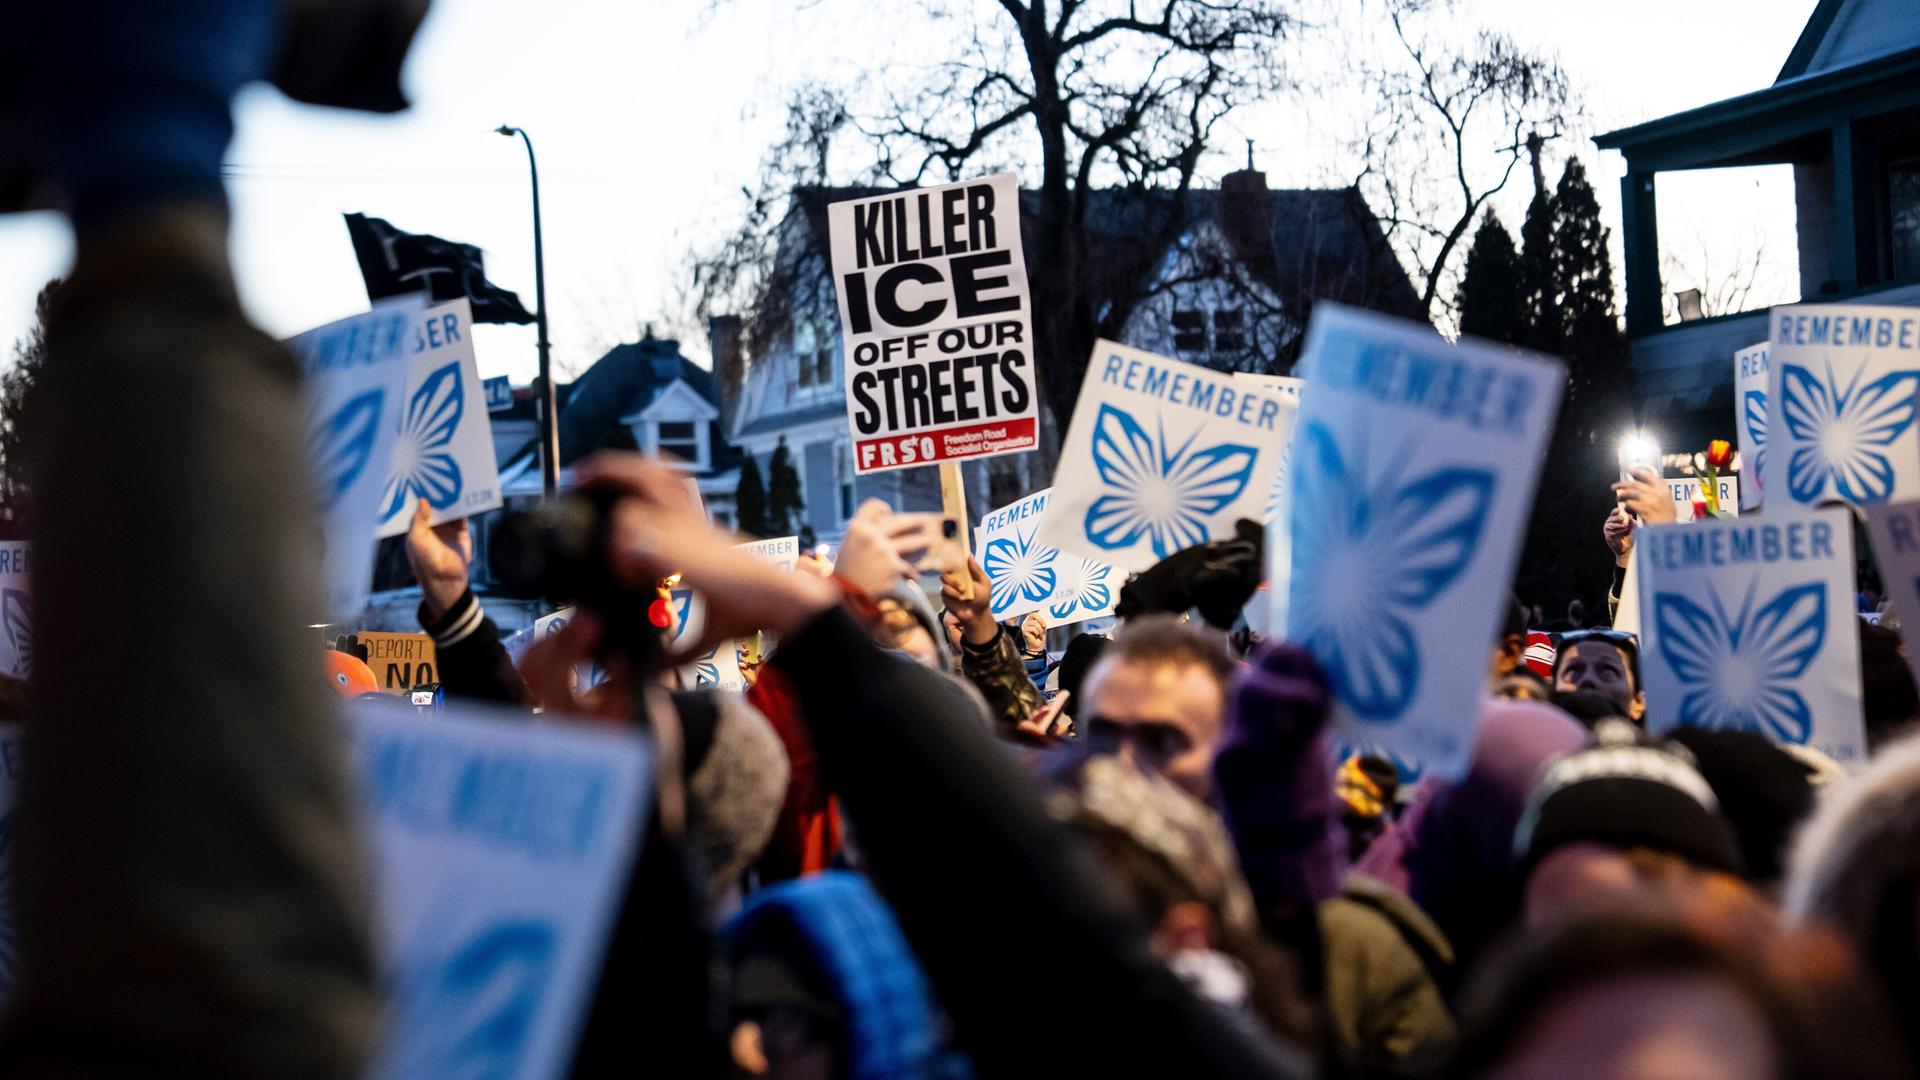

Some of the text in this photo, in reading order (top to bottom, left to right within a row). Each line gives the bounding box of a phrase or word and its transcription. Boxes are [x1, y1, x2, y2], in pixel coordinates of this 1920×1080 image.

[854, 183, 997, 269] KILLER
[844, 250, 1021, 334] ICE
[854, 320, 1024, 367] OFF OUR
[1780, 315, 1920, 349] REMEMBE
[852, 349, 1029, 435] STREETS
[1102, 354, 1280, 431] REMEMBER
[861, 436, 936, 469] FRSO
[943, 427, 1007, 445] Freedom Road
[364, 638, 428, 659] DEPORT
[386, 662, 433, 689] NO
